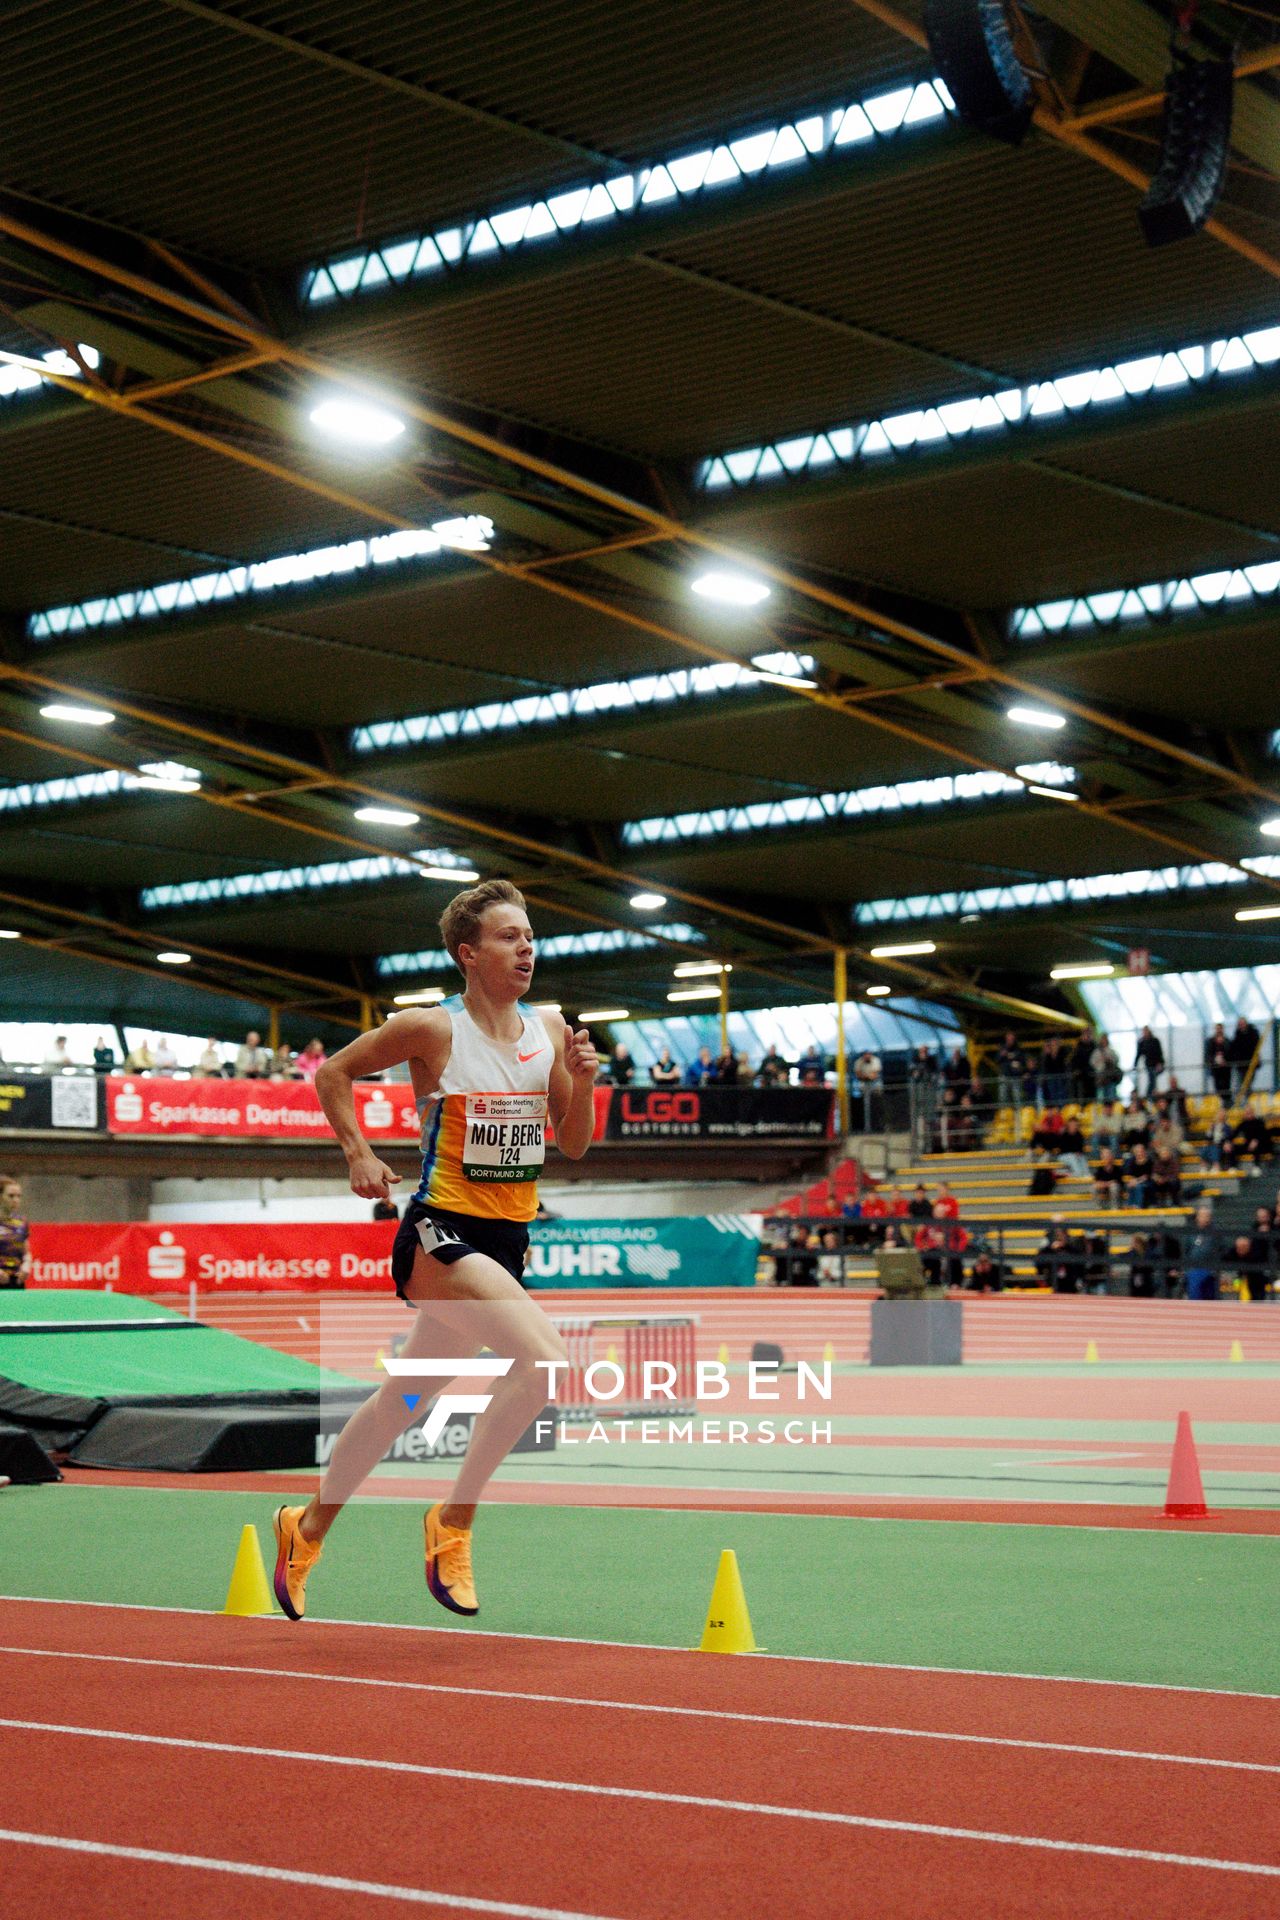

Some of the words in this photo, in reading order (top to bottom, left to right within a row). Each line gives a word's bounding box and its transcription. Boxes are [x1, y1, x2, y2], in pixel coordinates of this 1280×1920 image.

[149, 1102, 240, 1126] Sparkasse
[246, 1104, 331, 1127] Dortmun
[490, 1107, 522, 1115] Dortmund
[513, 1099, 534, 1107] Meeting
[621, 1092, 700, 1122] LGO
[471, 1122, 508, 1147] MOE
[510, 1123, 542, 1147] BERG
[500, 1147, 521, 1165] 124
[470, 1168, 515, 1178] DORTMUND
[515, 1169, 525, 1178] 26
[30, 1254, 120, 1281] tmund
[198, 1254, 331, 1284] Sparkasse
[340, 1254, 393, 1278] Dort
